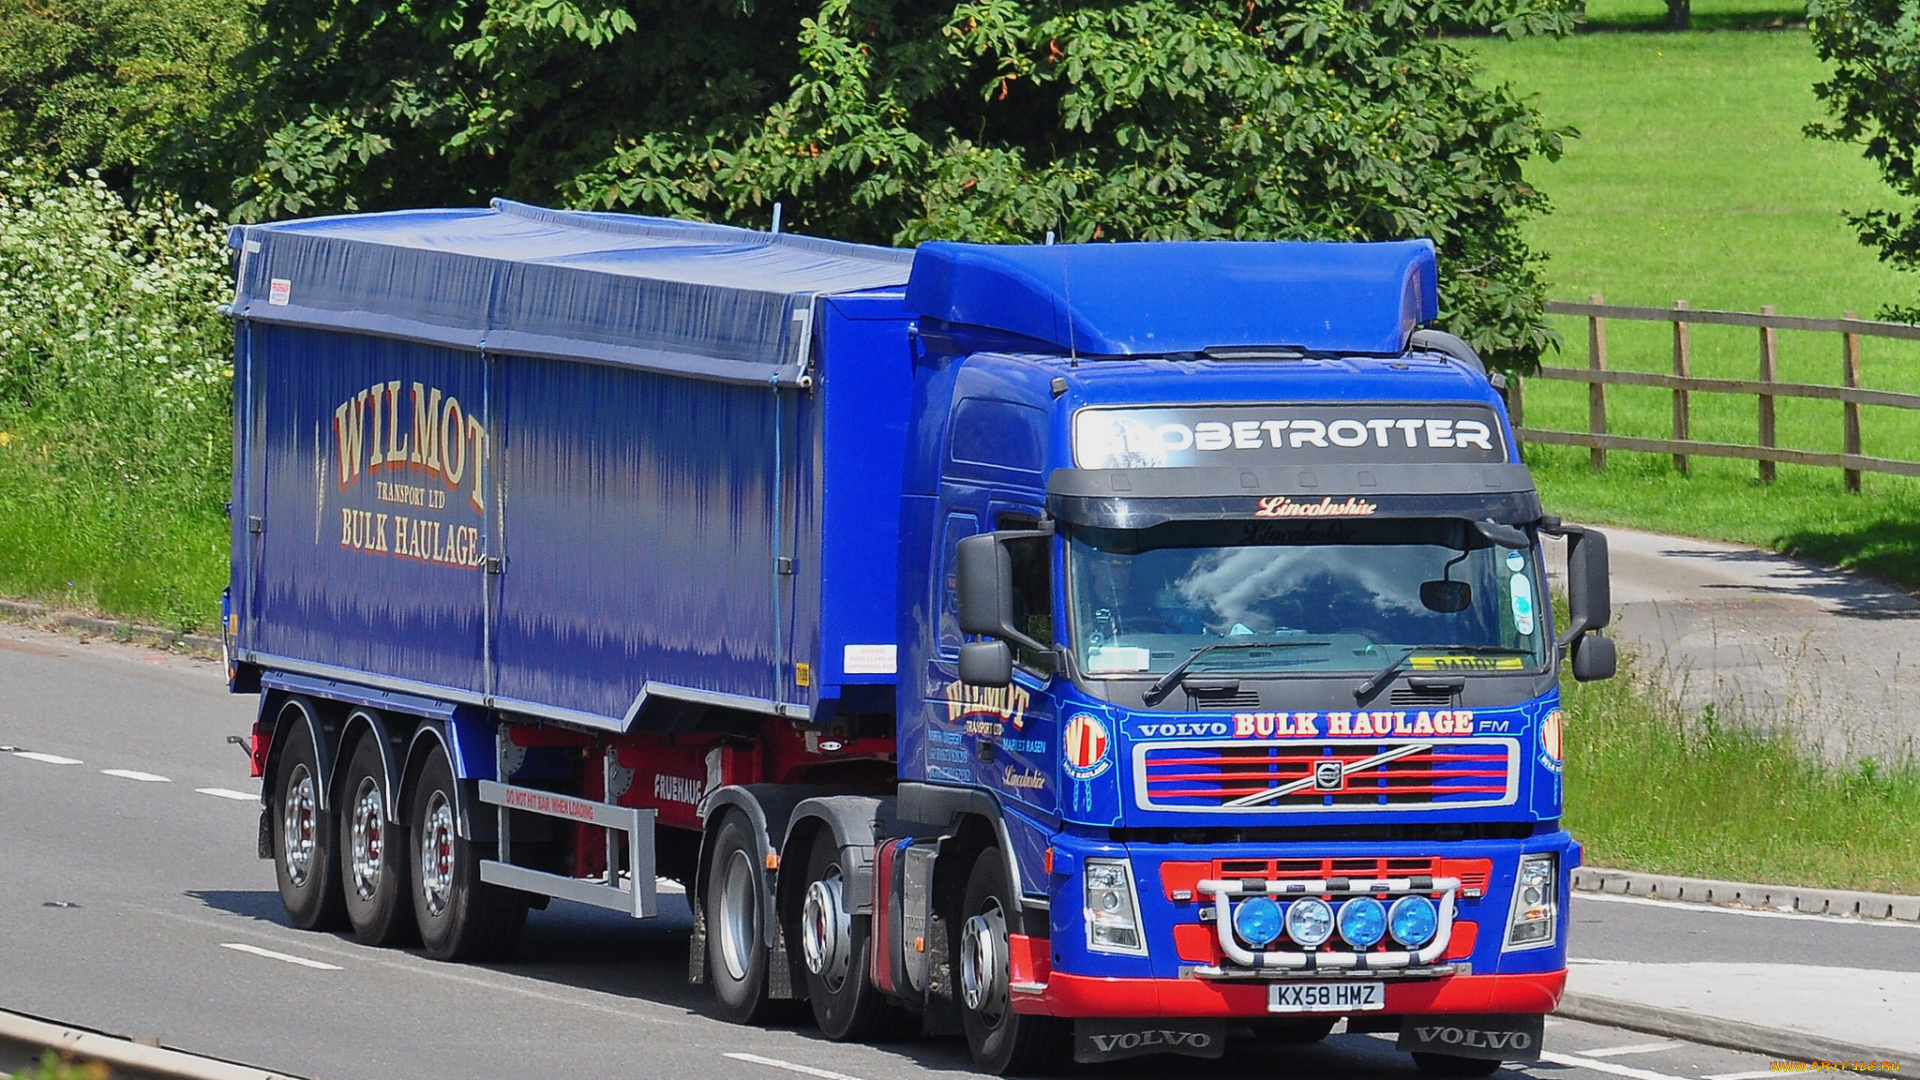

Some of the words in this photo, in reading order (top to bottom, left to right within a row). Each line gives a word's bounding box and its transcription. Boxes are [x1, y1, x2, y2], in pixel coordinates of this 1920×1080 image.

[333, 380, 489, 515] WILMOT
[377, 481, 424, 508] TRANSPORT
[428, 489, 445, 510] LTD
[1255, 496, 1377, 518] Lincolnshire
[341, 508, 388, 556] BULK
[394, 515, 479, 570] HAULAGE
[1137, 722, 1228, 737] VOLVO
[1232, 712, 1320, 738] BULK
[1326, 710, 1474, 738] HAULAGE
[1478, 719, 1510, 733] FM
[1003, 738, 1025, 752] MARKET
[1026, 739, 1046, 754] RASEN
[506, 788, 515, 805] DO
[515, 791, 527, 807] NOT
[654, 773, 702, 806] FRUEHAUF
[1277, 985, 1331, 1006] KX58
[1336, 984, 1377, 1005] HMZ
[1088, 1029, 1212, 1052] VOLVO
[1414, 1026, 1532, 1050] VOLVO
